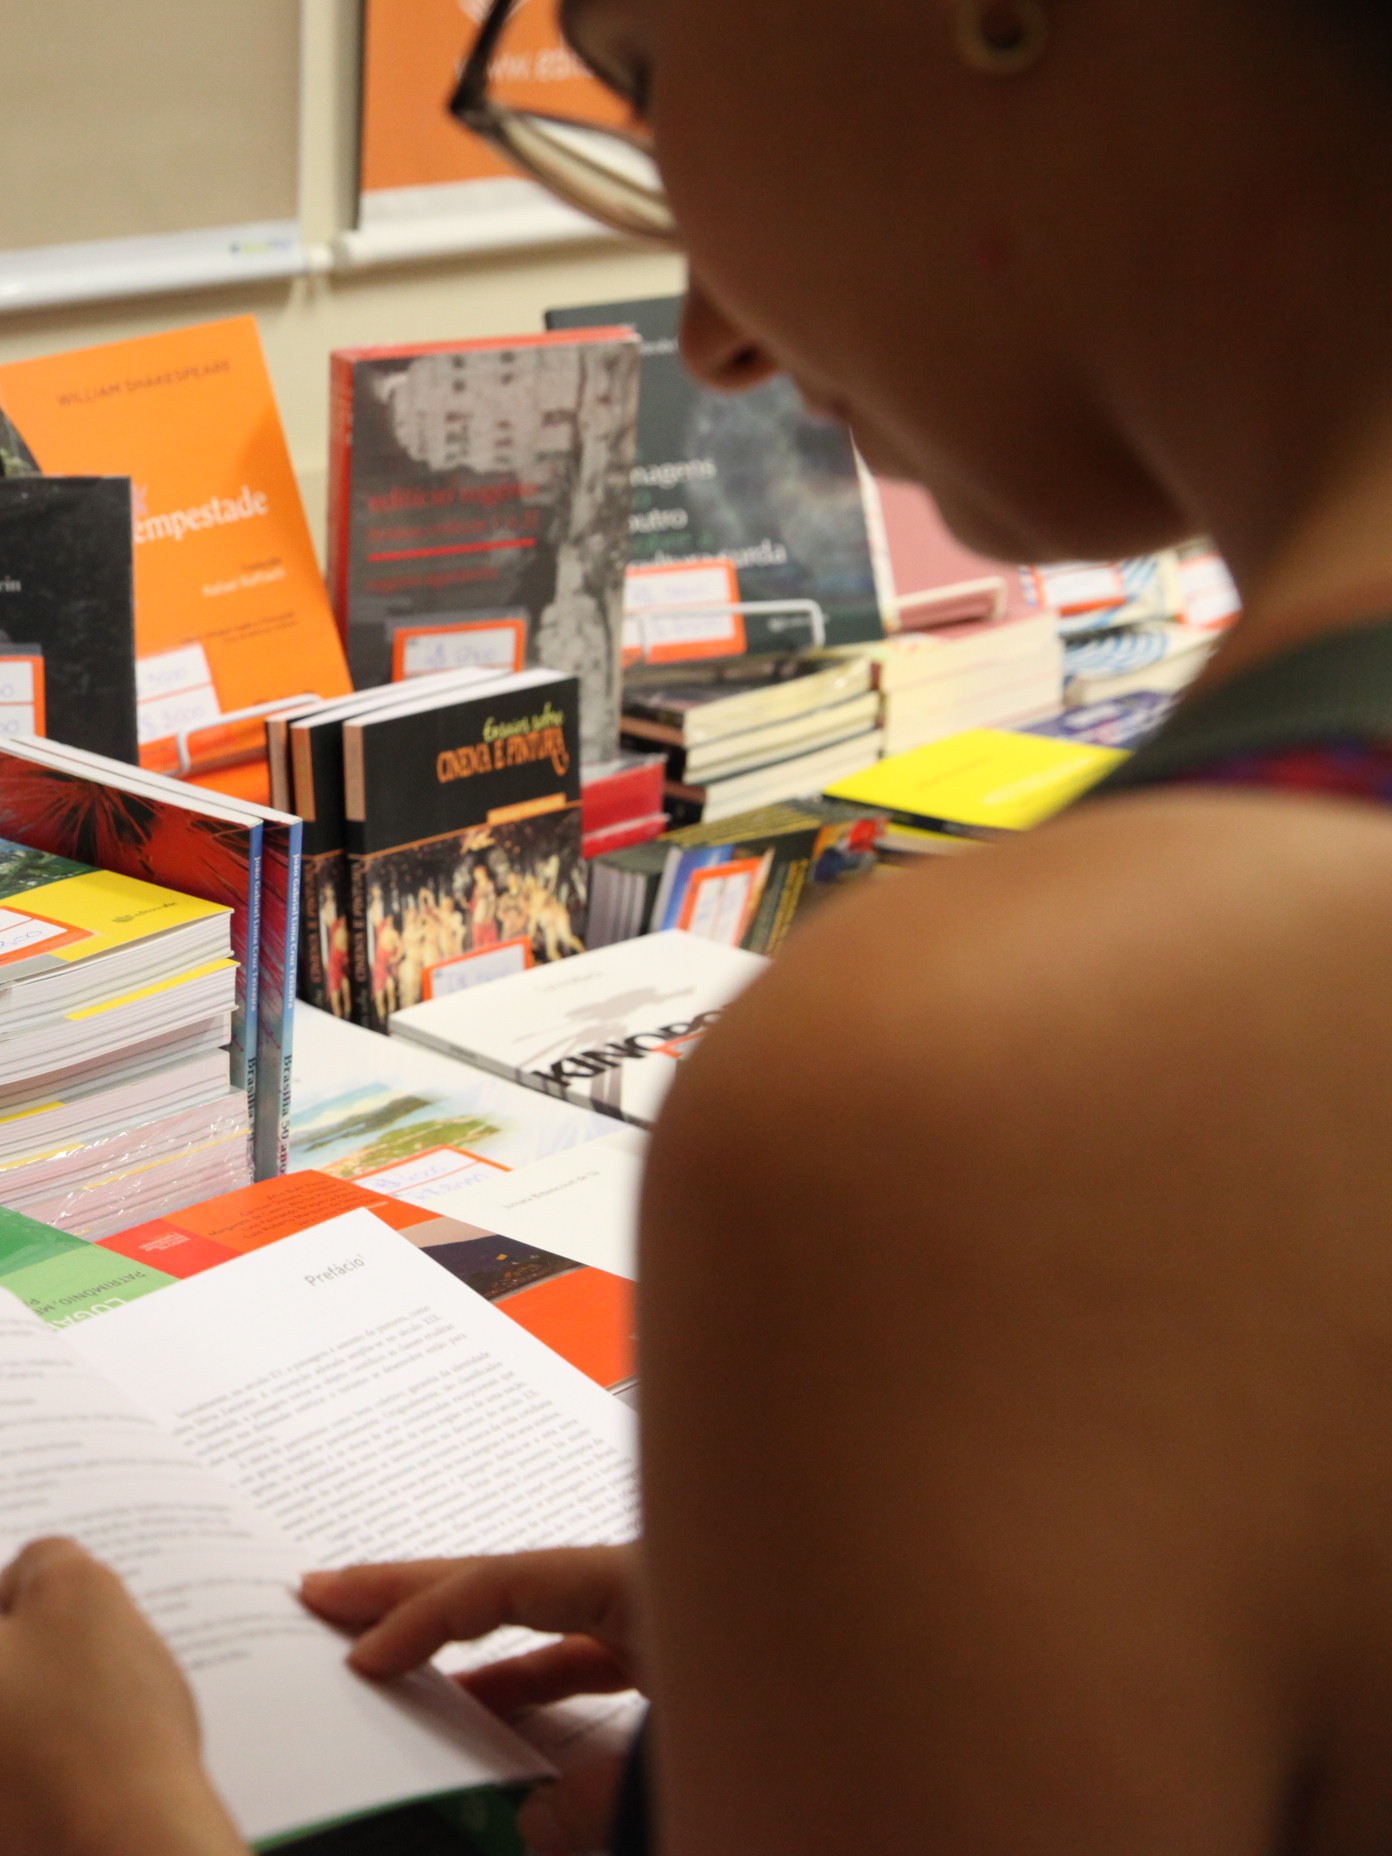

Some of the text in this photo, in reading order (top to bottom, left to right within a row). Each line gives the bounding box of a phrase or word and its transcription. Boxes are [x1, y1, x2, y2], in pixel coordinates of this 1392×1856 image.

[292, 853, 301, 877] João
[291, 877, 300, 911] Gabriel
[290, 911, 299, 933] Lima
[289, 935, 298, 957] Cruz
[303, 1255, 366, 1287] Prefácio
